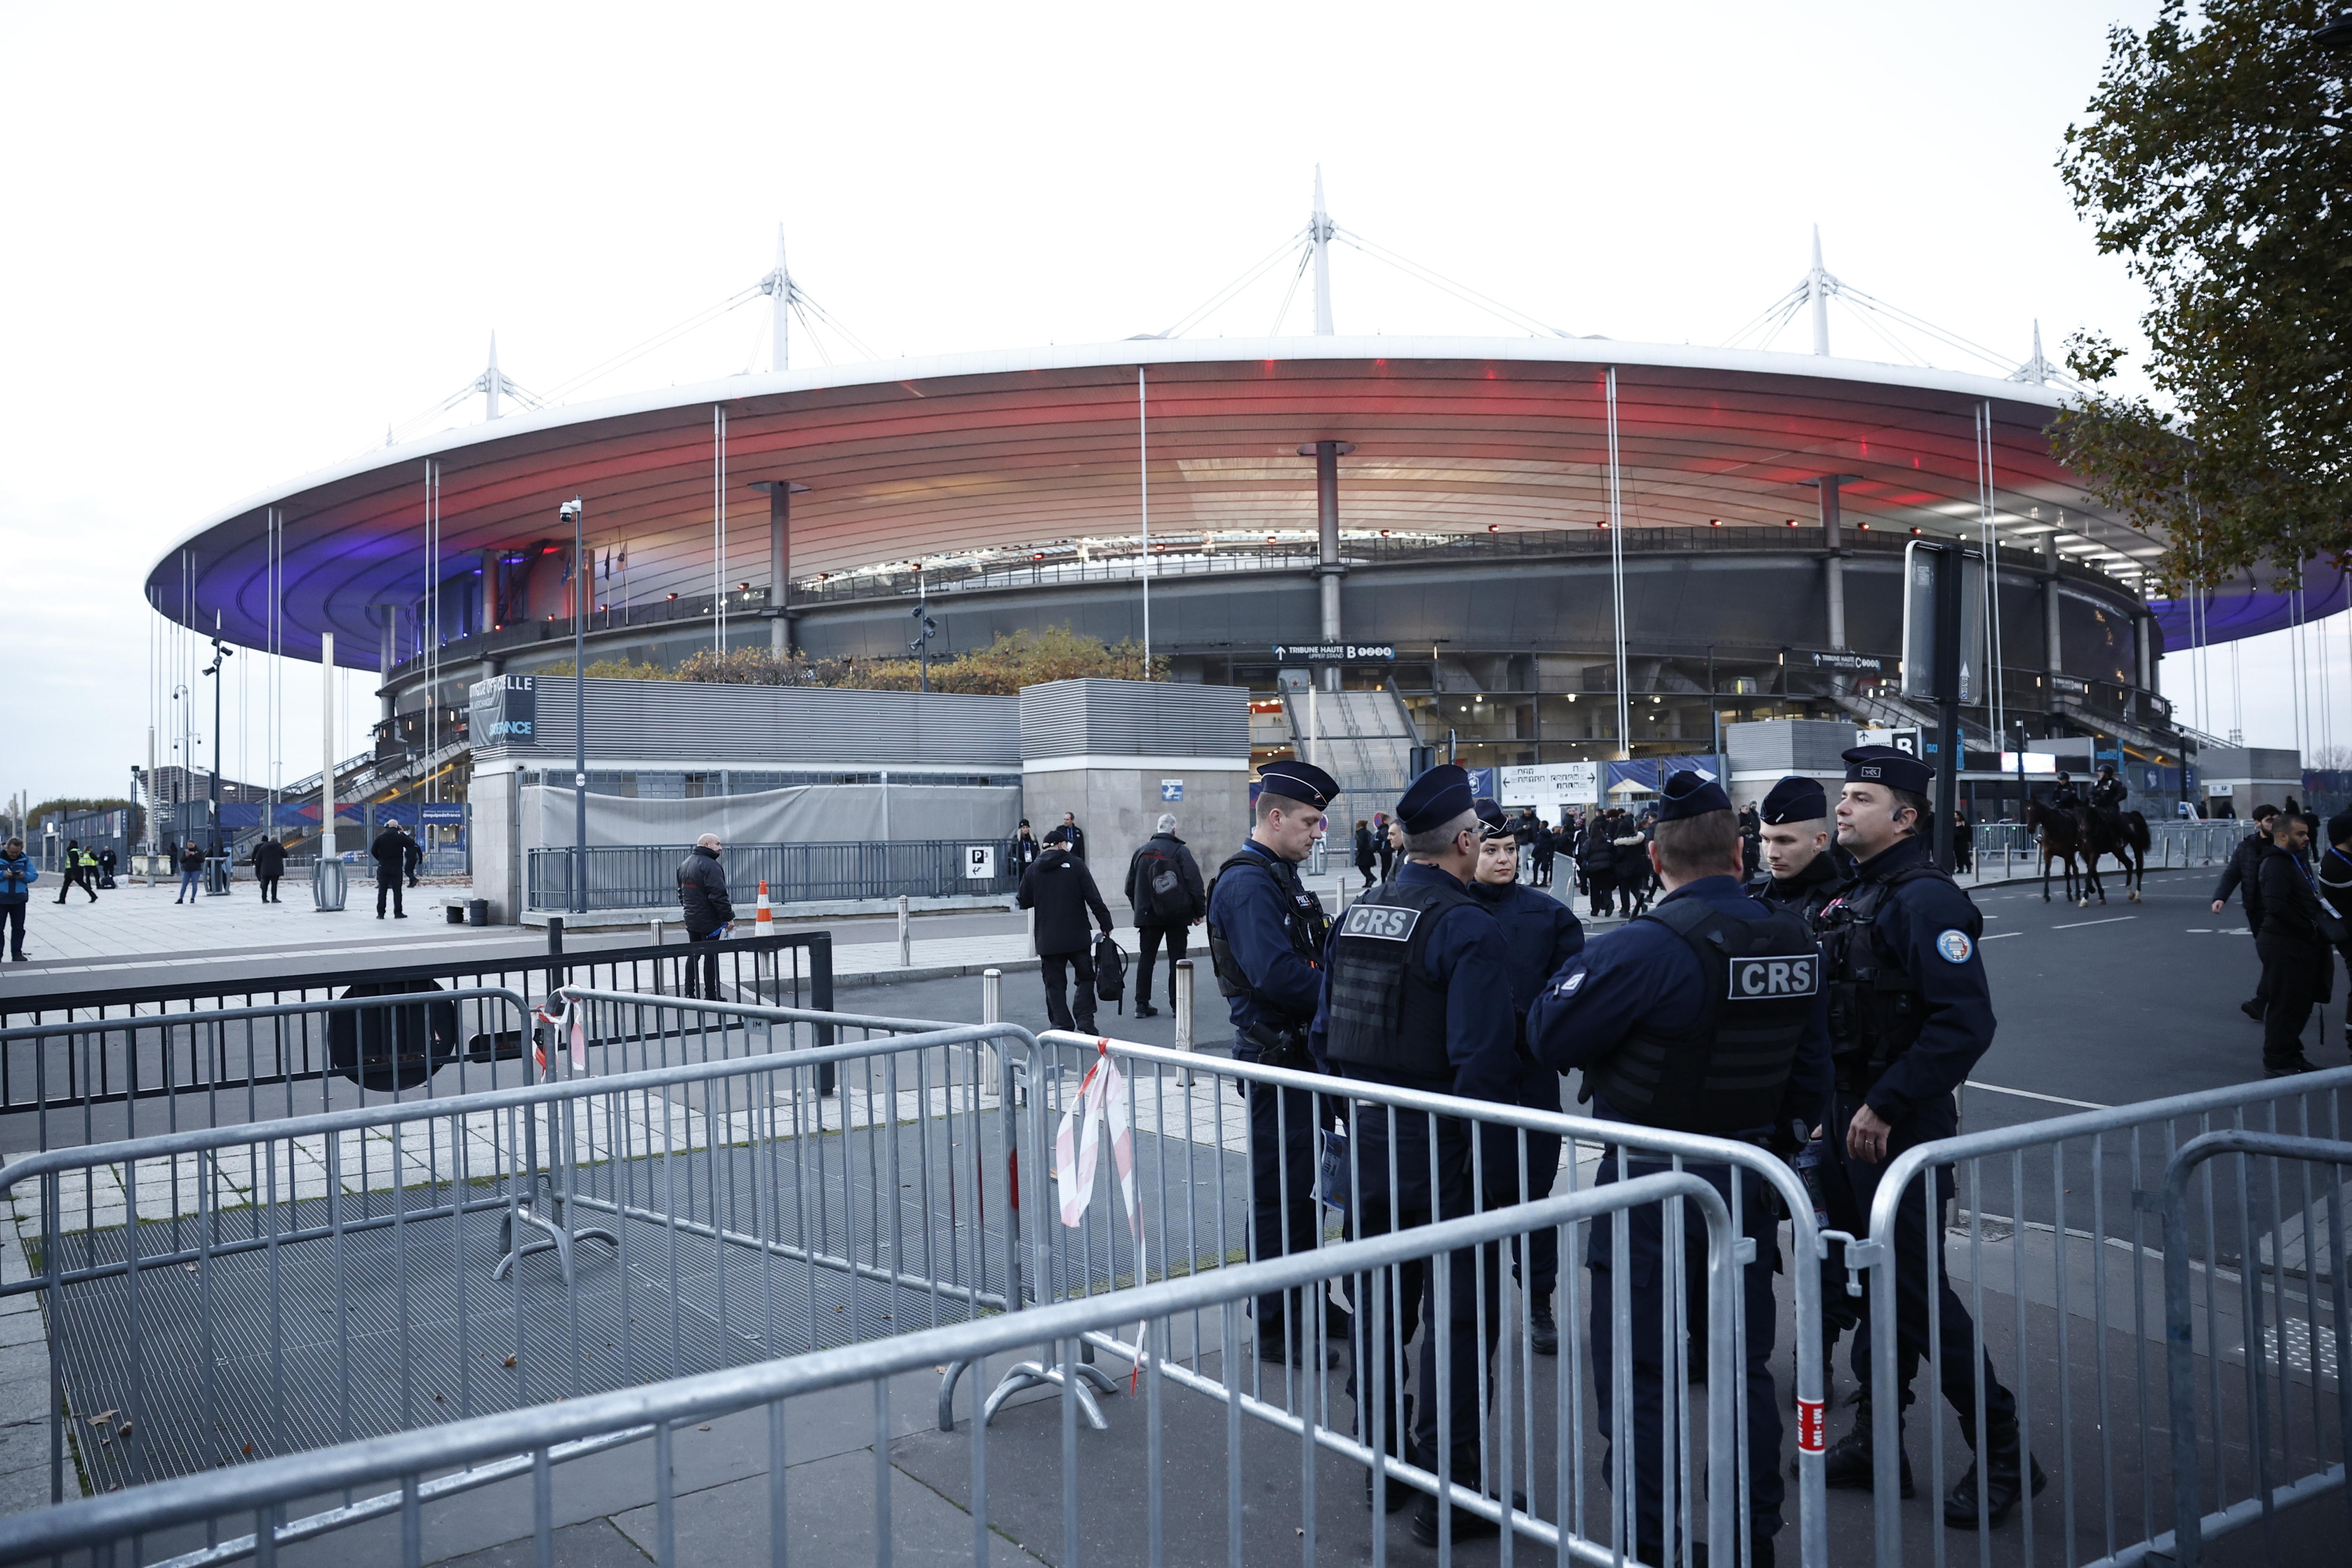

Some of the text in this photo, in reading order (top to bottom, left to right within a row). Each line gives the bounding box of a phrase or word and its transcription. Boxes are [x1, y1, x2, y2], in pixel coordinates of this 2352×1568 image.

[1347, 645, 1356, 658] B
[1855, 657, 1861, 668] C
[975, 851, 982, 862] P
[1351, 909, 1406, 935] CRS
[1742, 961, 1810, 995] CRS
